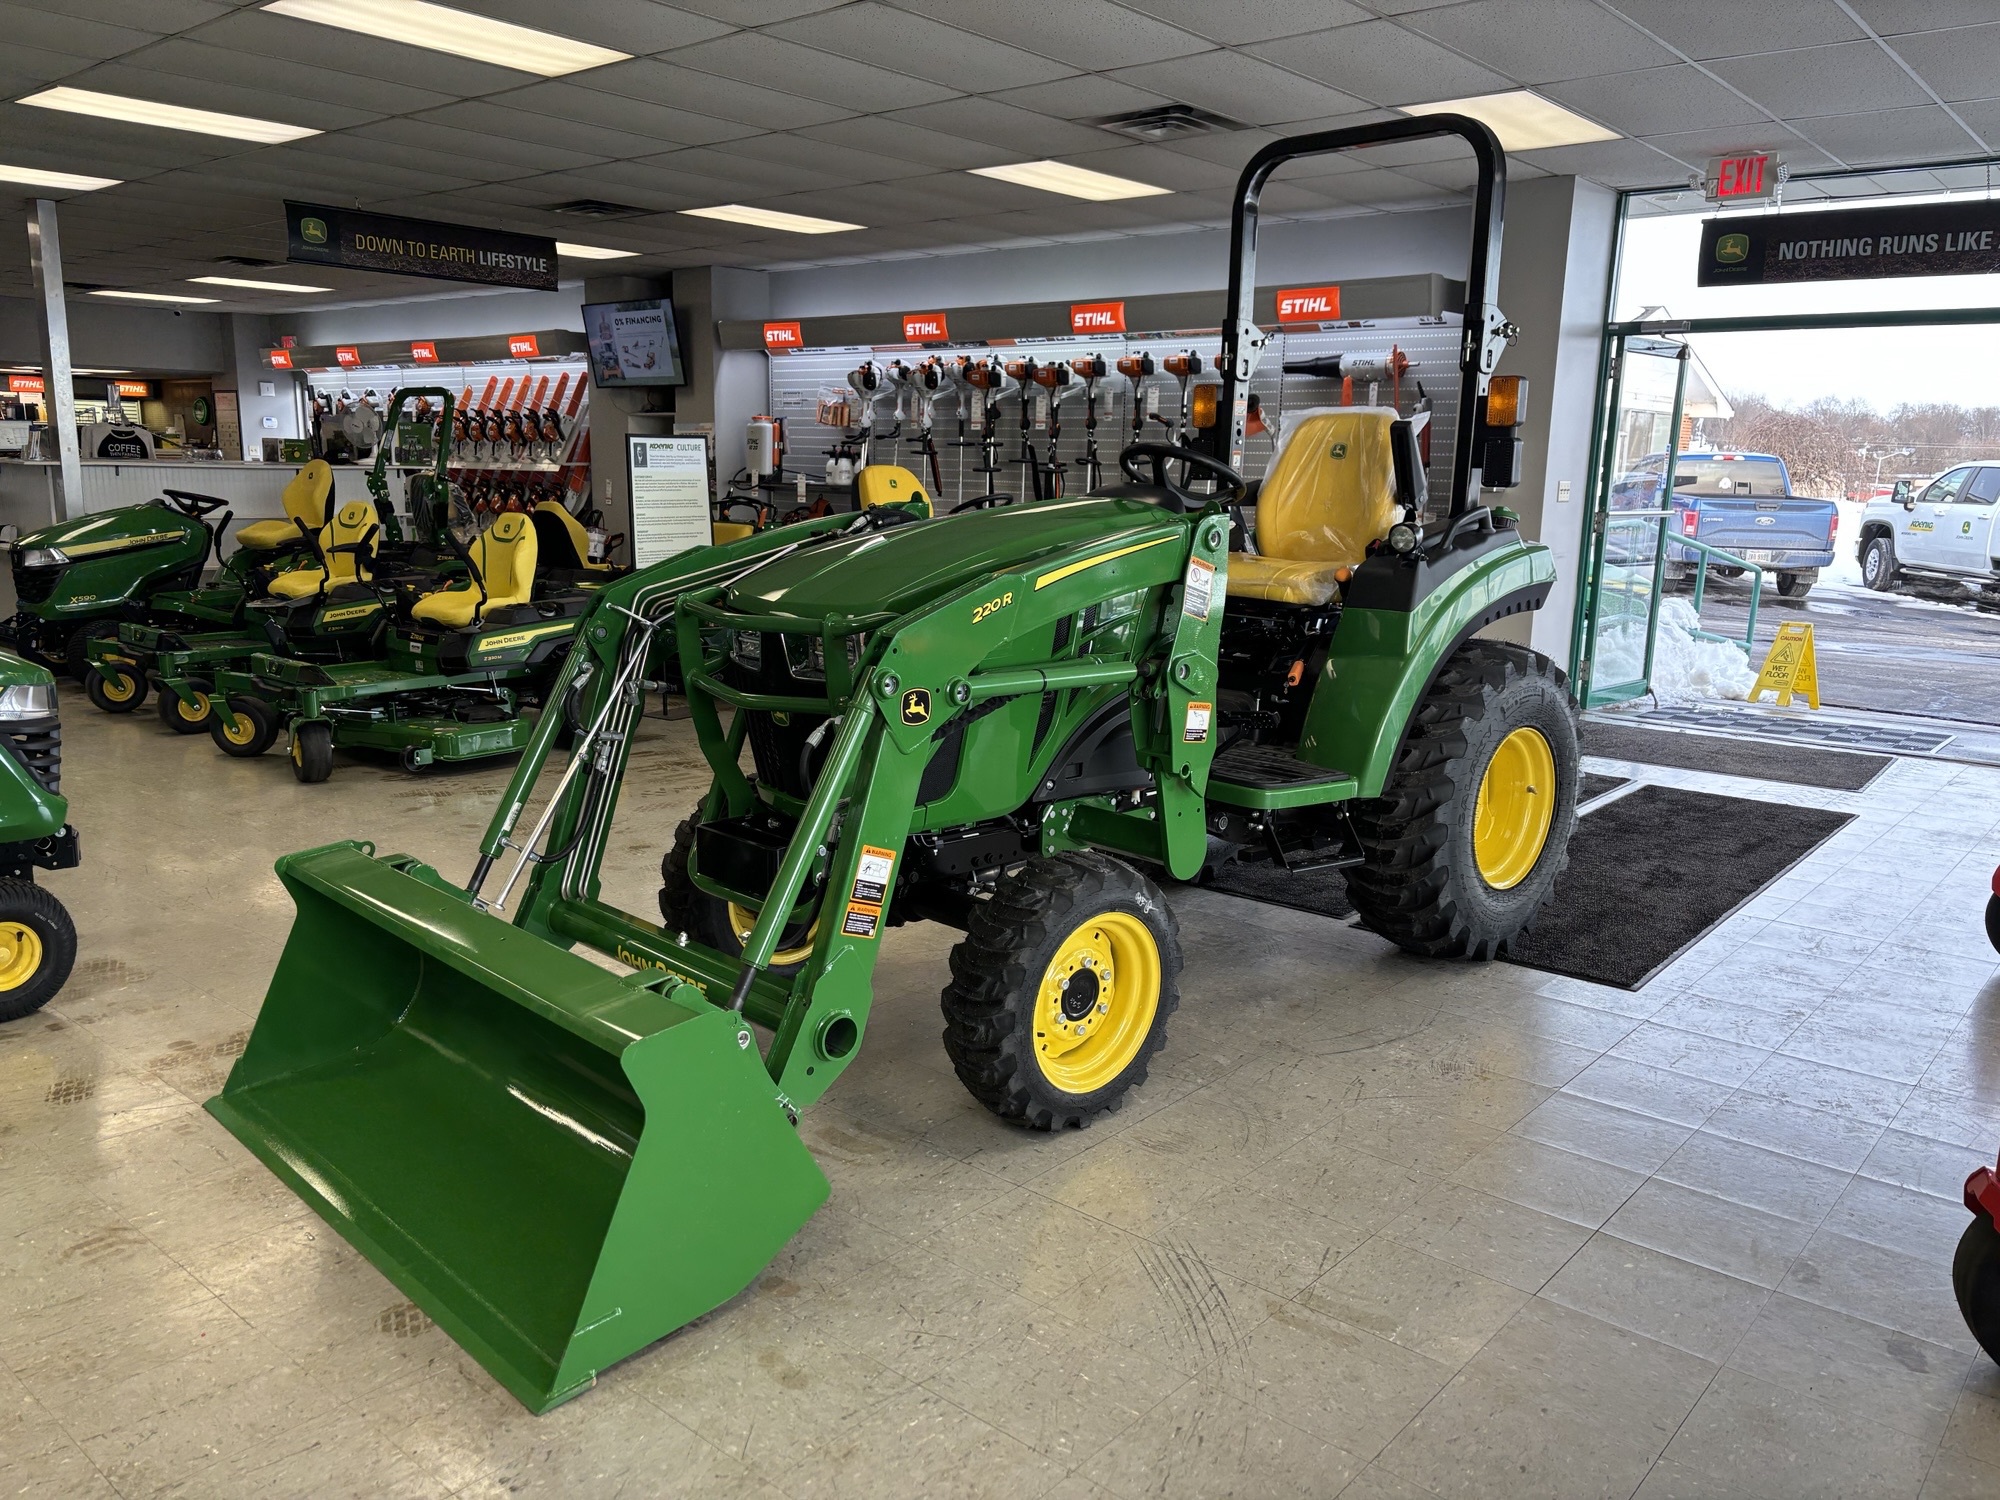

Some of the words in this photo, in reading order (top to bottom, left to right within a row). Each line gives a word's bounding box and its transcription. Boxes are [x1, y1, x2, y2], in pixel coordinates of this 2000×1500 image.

[1718, 156, 1768, 197] EXIT
[1778, 237, 1873, 261] NOTHING
[1879, 234, 1939, 256] RUNS
[1945, 230, 1994, 252] LIKE
[355, 233, 404, 255] DOWN
[407, 241, 426, 257] TO
[431, 244, 475, 264] EARTH
[479, 250, 548, 273] LIFESTYLE
[1280, 296, 1332, 314] STIHL
[614, 318, 625, 326] 0%
[625, 315, 662, 325] FINANCING
[1073, 312, 1116, 327] STIHL
[906, 323, 941, 336] STIHL
[766, 330, 796, 342] STIHL
[413, 348, 433, 358] STIHL
[510, 342, 534, 353] STIHL
[271, 355, 287, 365] STIHL
[337, 352, 355, 362] STIHL
[1352, 359, 1376, 367] STIHL
[12, 380, 43, 388] STIHL
[120, 384, 147, 393] STIHL
[108, 443, 141, 454] COFFEE
[676, 443, 702, 452] CULTURE
[147, 533, 169, 543] DEERE
[70, 594, 97, 604] X590
[330, 611, 346, 619] JOHN
[346, 608, 367, 616] DEERE
[485, 639, 504, 647] JOHN
[504, 635, 526, 644] DEERE
[1772, 664, 1789, 672] WET
[1765, 671, 1790, 679] FLOOR
[871, 849, 892, 858] WARNING
[616, 944, 652, 971] JOHN
